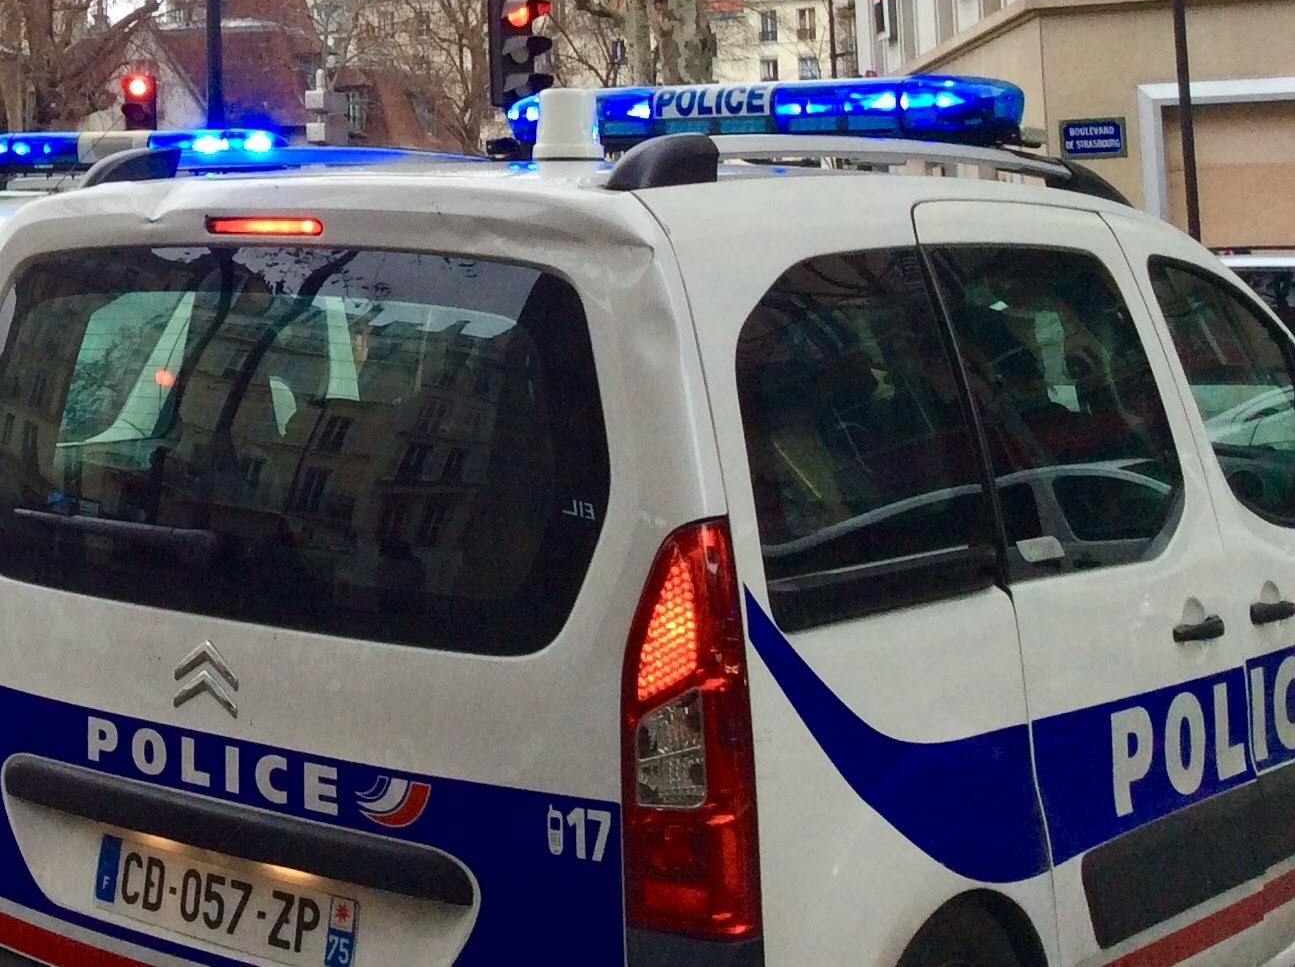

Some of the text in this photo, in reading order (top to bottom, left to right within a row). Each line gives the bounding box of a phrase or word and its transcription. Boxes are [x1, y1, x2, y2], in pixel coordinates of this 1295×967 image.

[656, 87, 768, 117] POLICE
[1065, 139, 1120, 150] DE STRASBOURG
[1069, 126, 1115, 136] BOULEVARD
[87, 715, 339, 816] POLICE
[566, 807, 611, 863] 17
[121, 852, 320, 952] CD-057-ZP
[326, 934, 351, 964] 75
